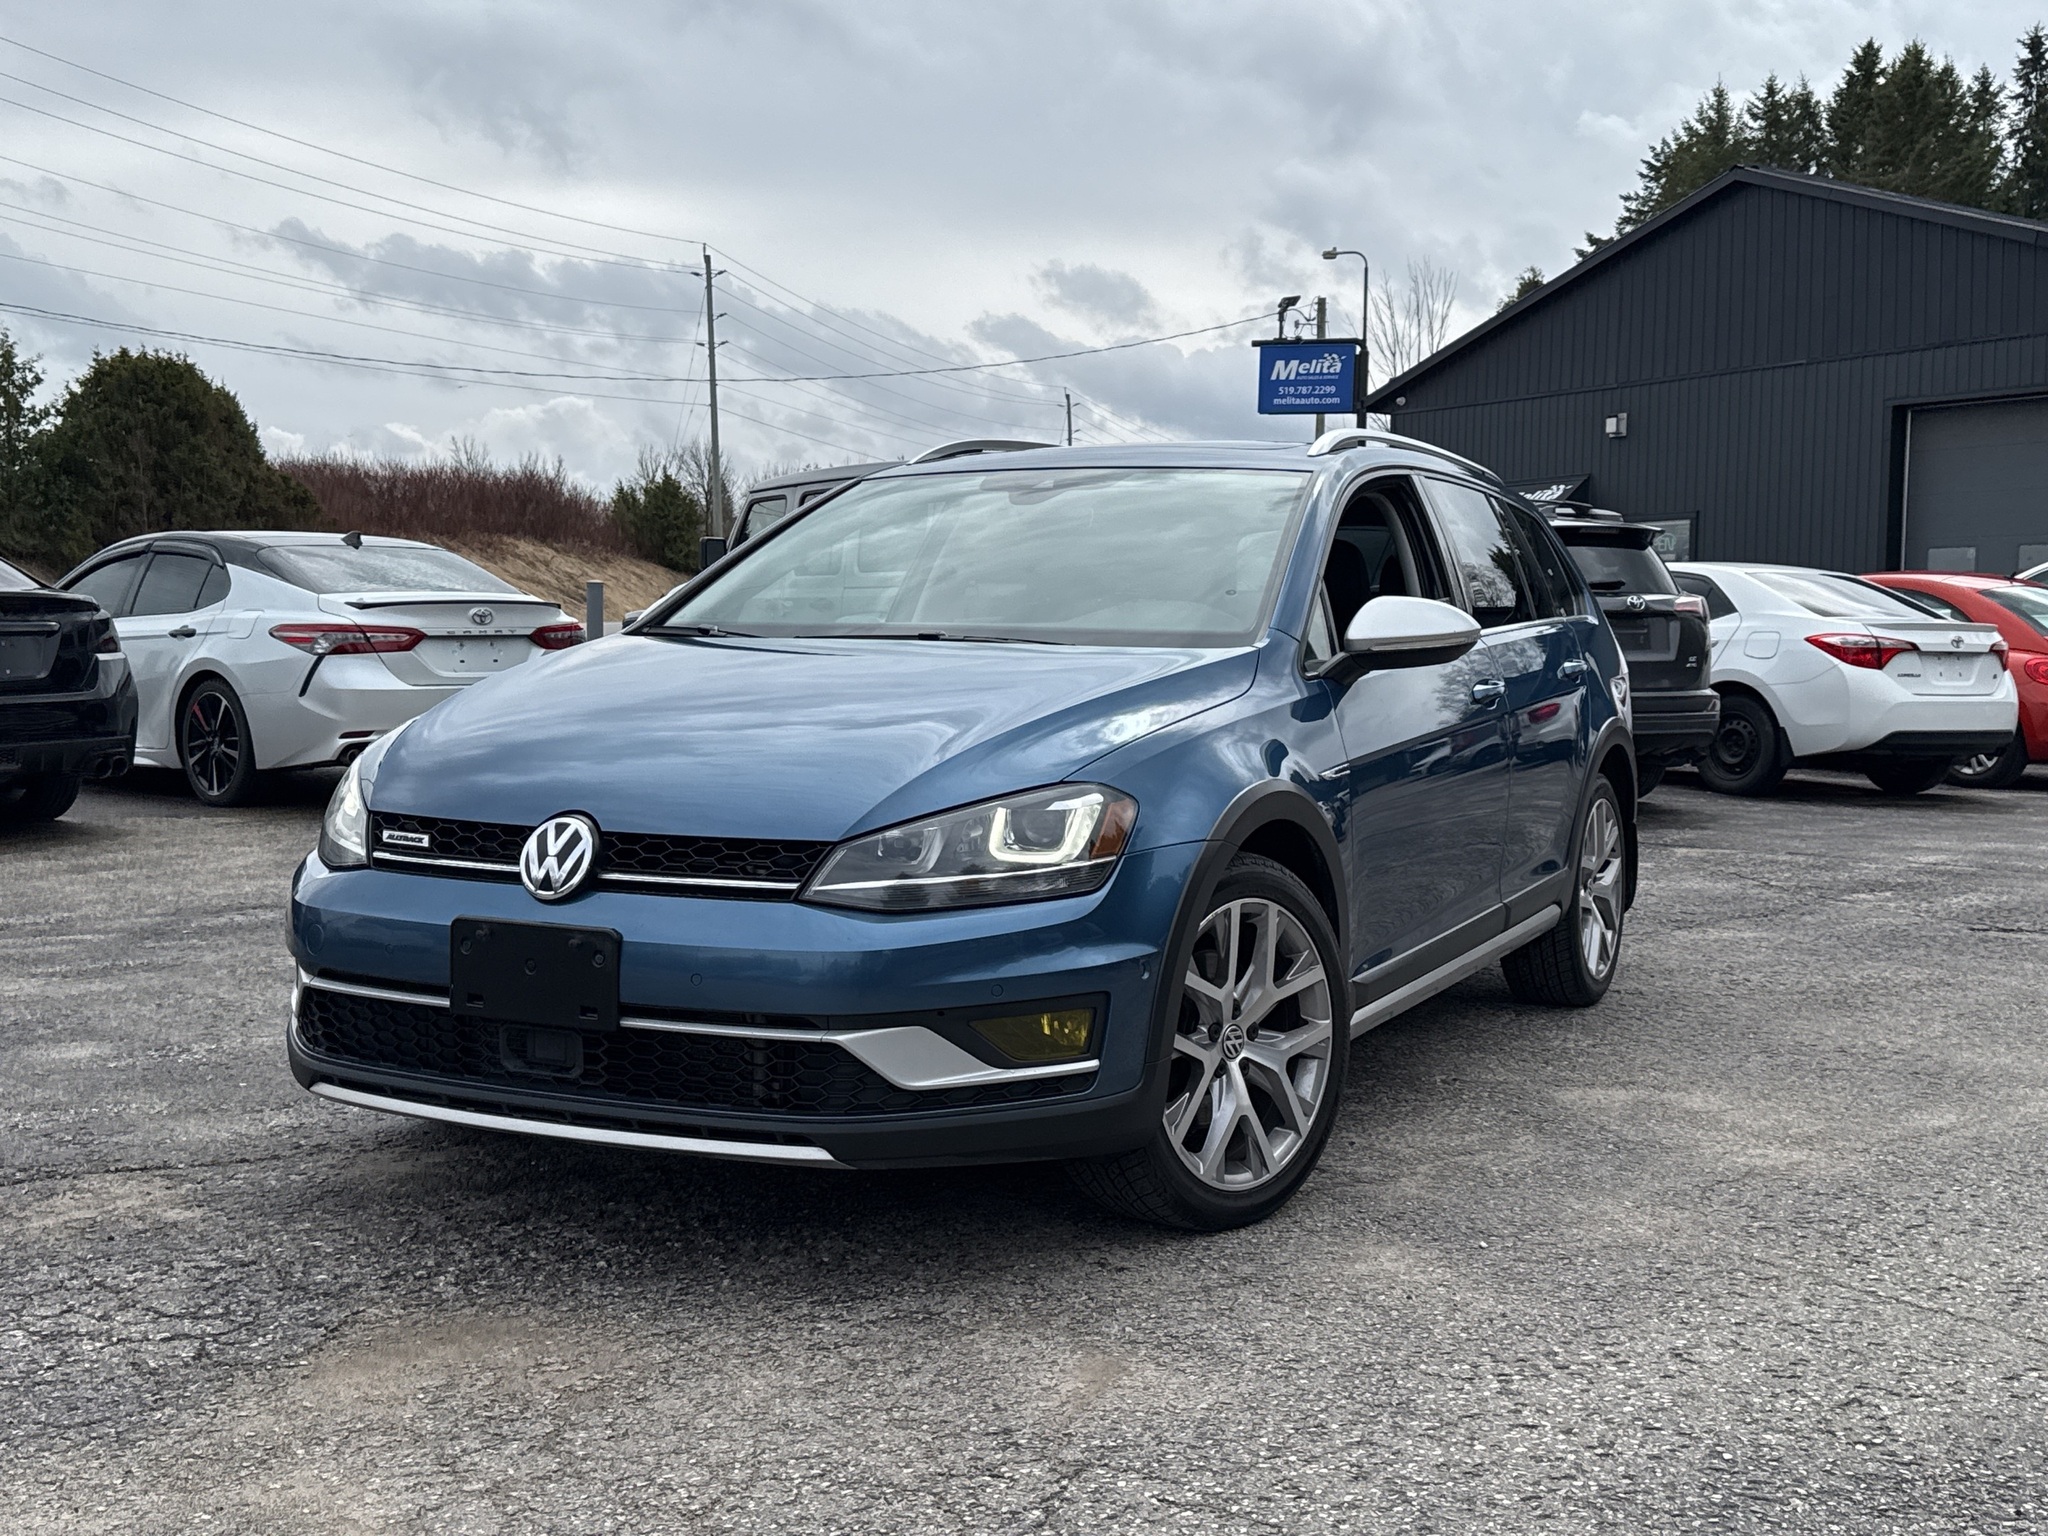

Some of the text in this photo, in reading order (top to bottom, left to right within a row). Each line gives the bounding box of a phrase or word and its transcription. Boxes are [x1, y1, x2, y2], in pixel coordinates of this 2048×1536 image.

[1270, 357, 1342, 380] Melita
[1278, 386, 1336, 395] 519.787.2299
[1273, 397, 1340, 405] melitaauto.com
[522, 818, 591, 897] VW
